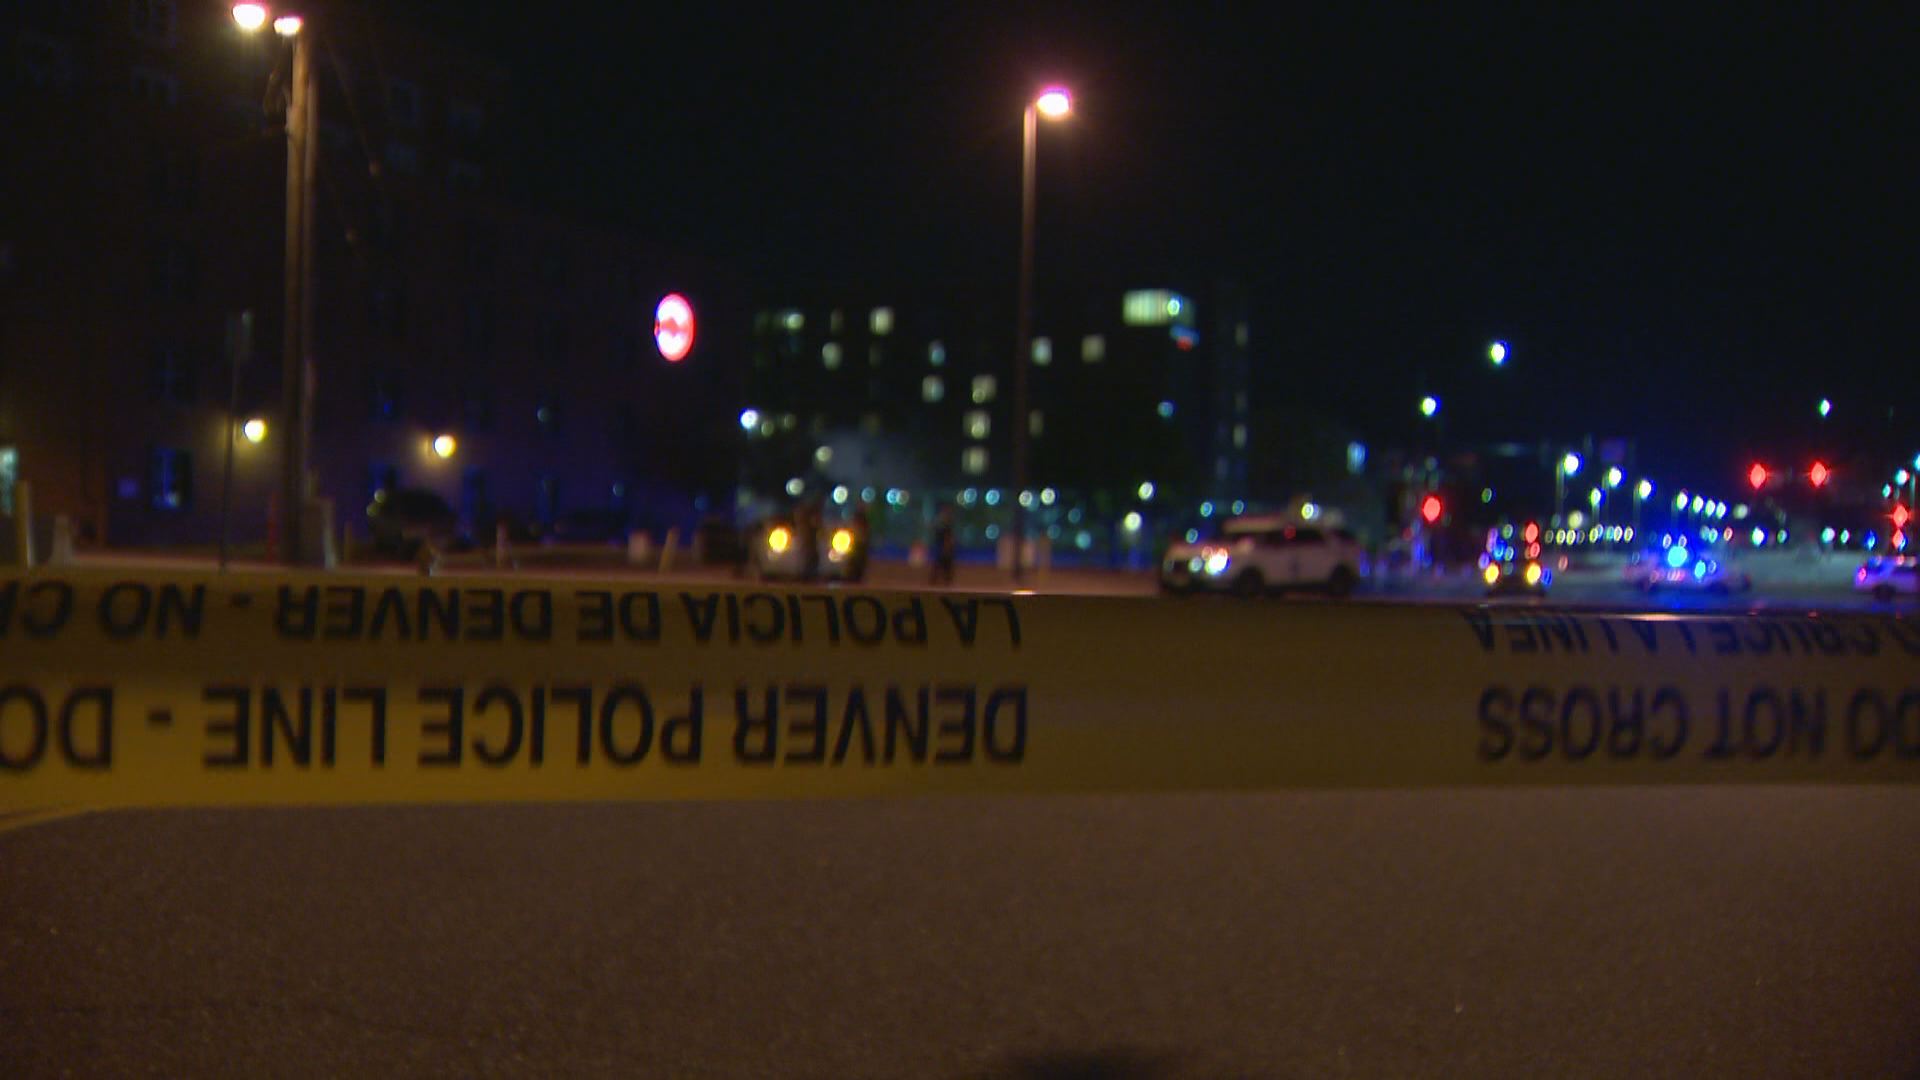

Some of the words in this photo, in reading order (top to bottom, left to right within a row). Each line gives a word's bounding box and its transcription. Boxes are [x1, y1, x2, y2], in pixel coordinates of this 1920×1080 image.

[98, 579, 205, 642] NO
[276, 584, 552, 641] DENVER
[576, 589, 662, 642] DE
[680, 591, 928, 643] POLICIA
[942, 595, 1022, 643] LA
[0, 684, 113, 770] DO
[203, 686, 386, 768] LINE
[418, 684, 702, 767] POLICE
[733, 684, 1027, 765] DENVER
[1476, 684, 1688, 761] CROSS
[1705, 686, 1826, 760] NOT
